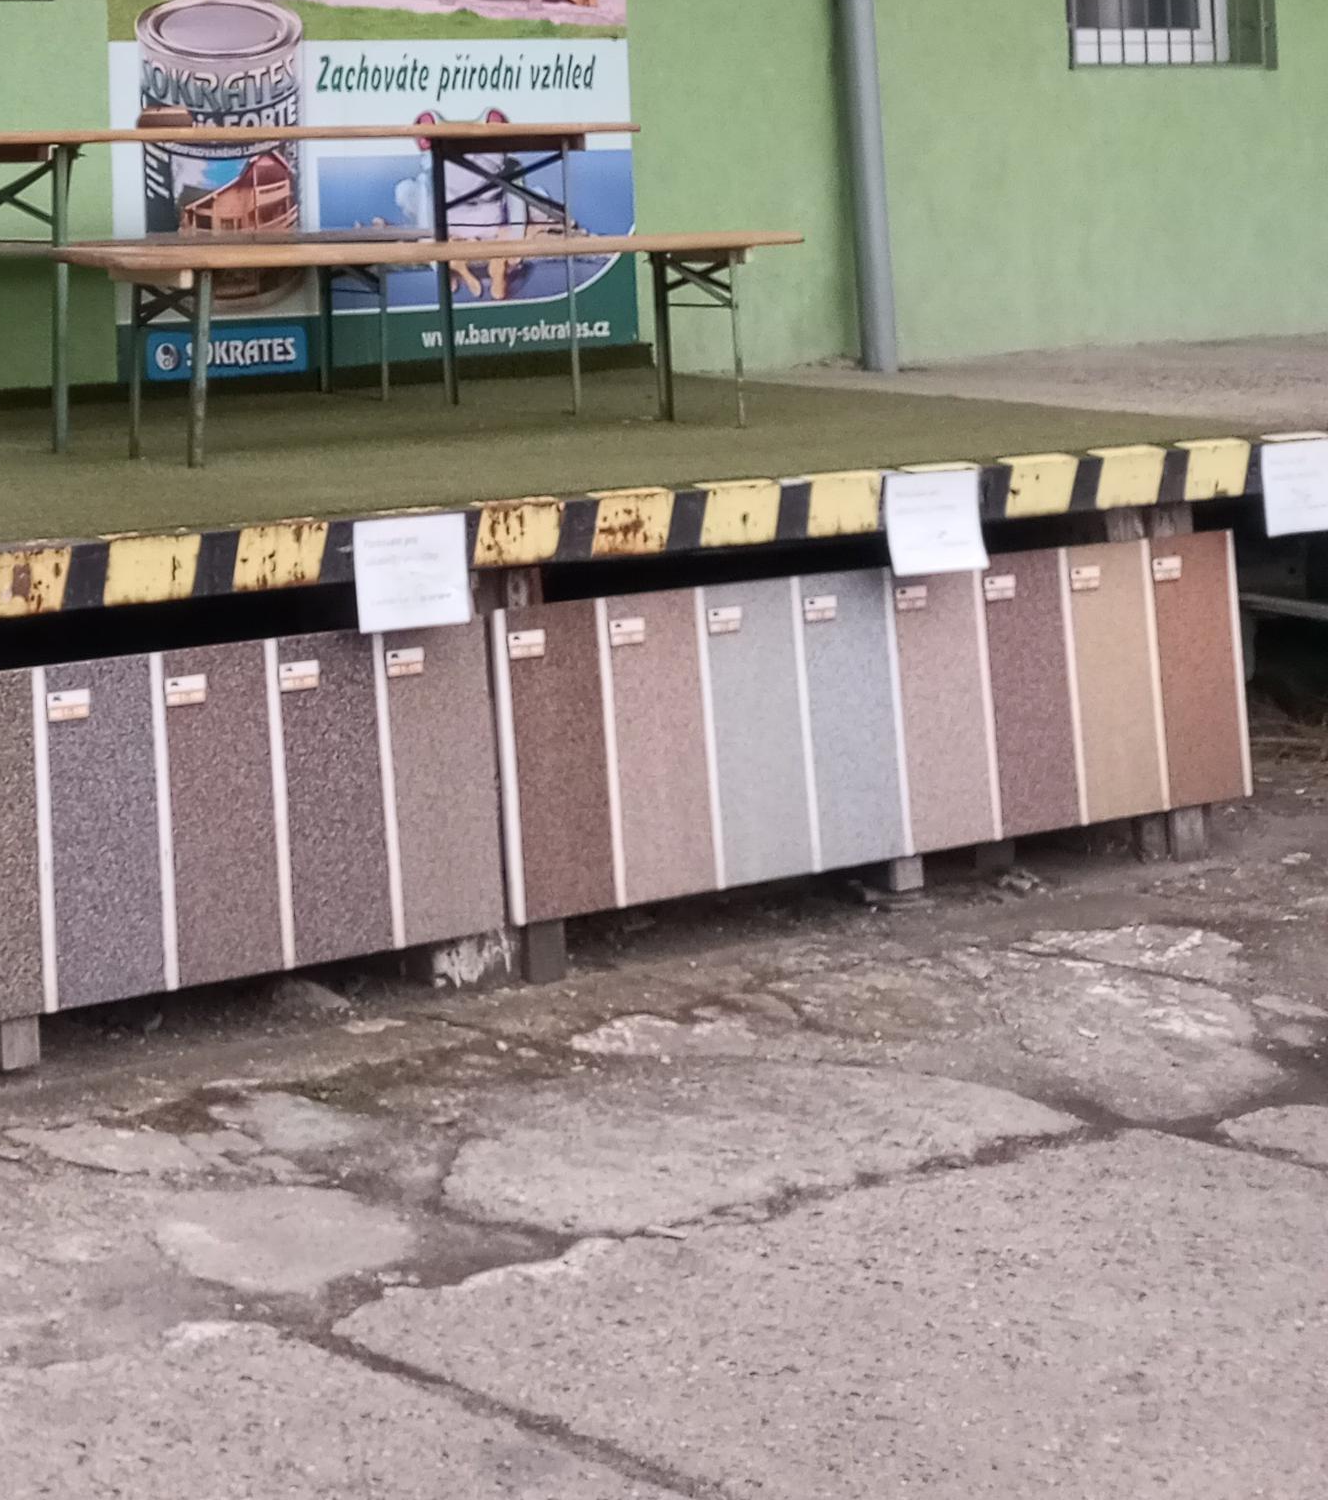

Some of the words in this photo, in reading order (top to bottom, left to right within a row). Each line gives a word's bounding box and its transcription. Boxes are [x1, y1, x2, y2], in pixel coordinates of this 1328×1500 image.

[316, 53, 430, 93] Zachováte
[436, 54, 524, 102] přírodní
[530, 53, 596, 92] vzhled
